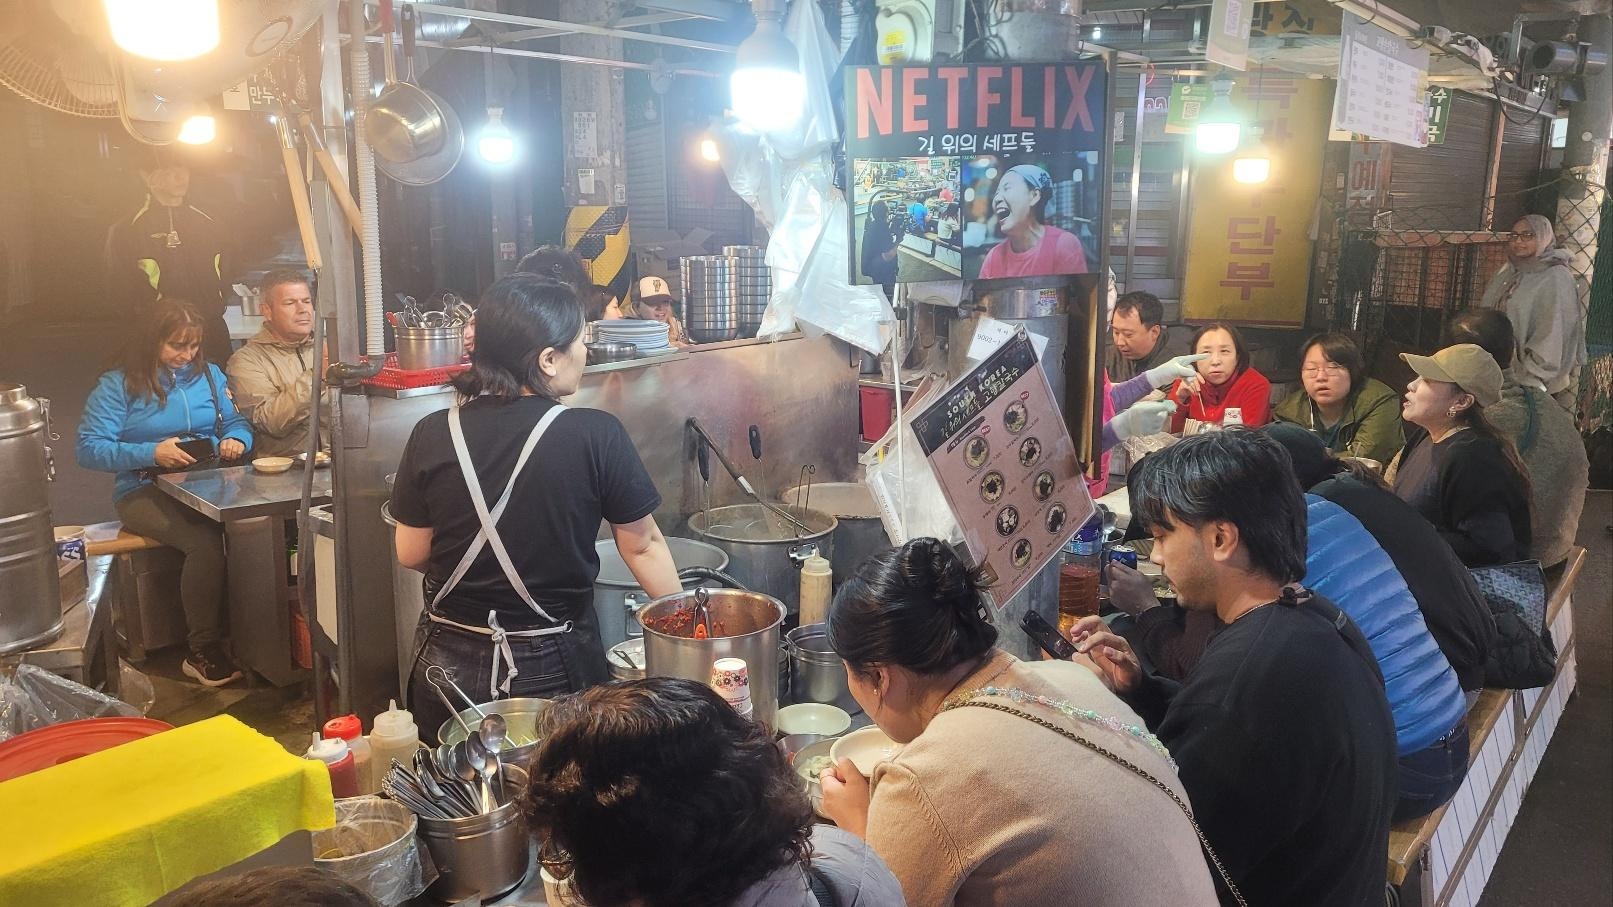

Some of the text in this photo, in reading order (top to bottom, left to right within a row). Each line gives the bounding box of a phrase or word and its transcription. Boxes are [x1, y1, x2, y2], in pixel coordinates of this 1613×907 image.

[857, 65, 1096, 140] NETFLIX
[918, 135, 936, 155] 길
[942, 133, 978, 154] 위의
